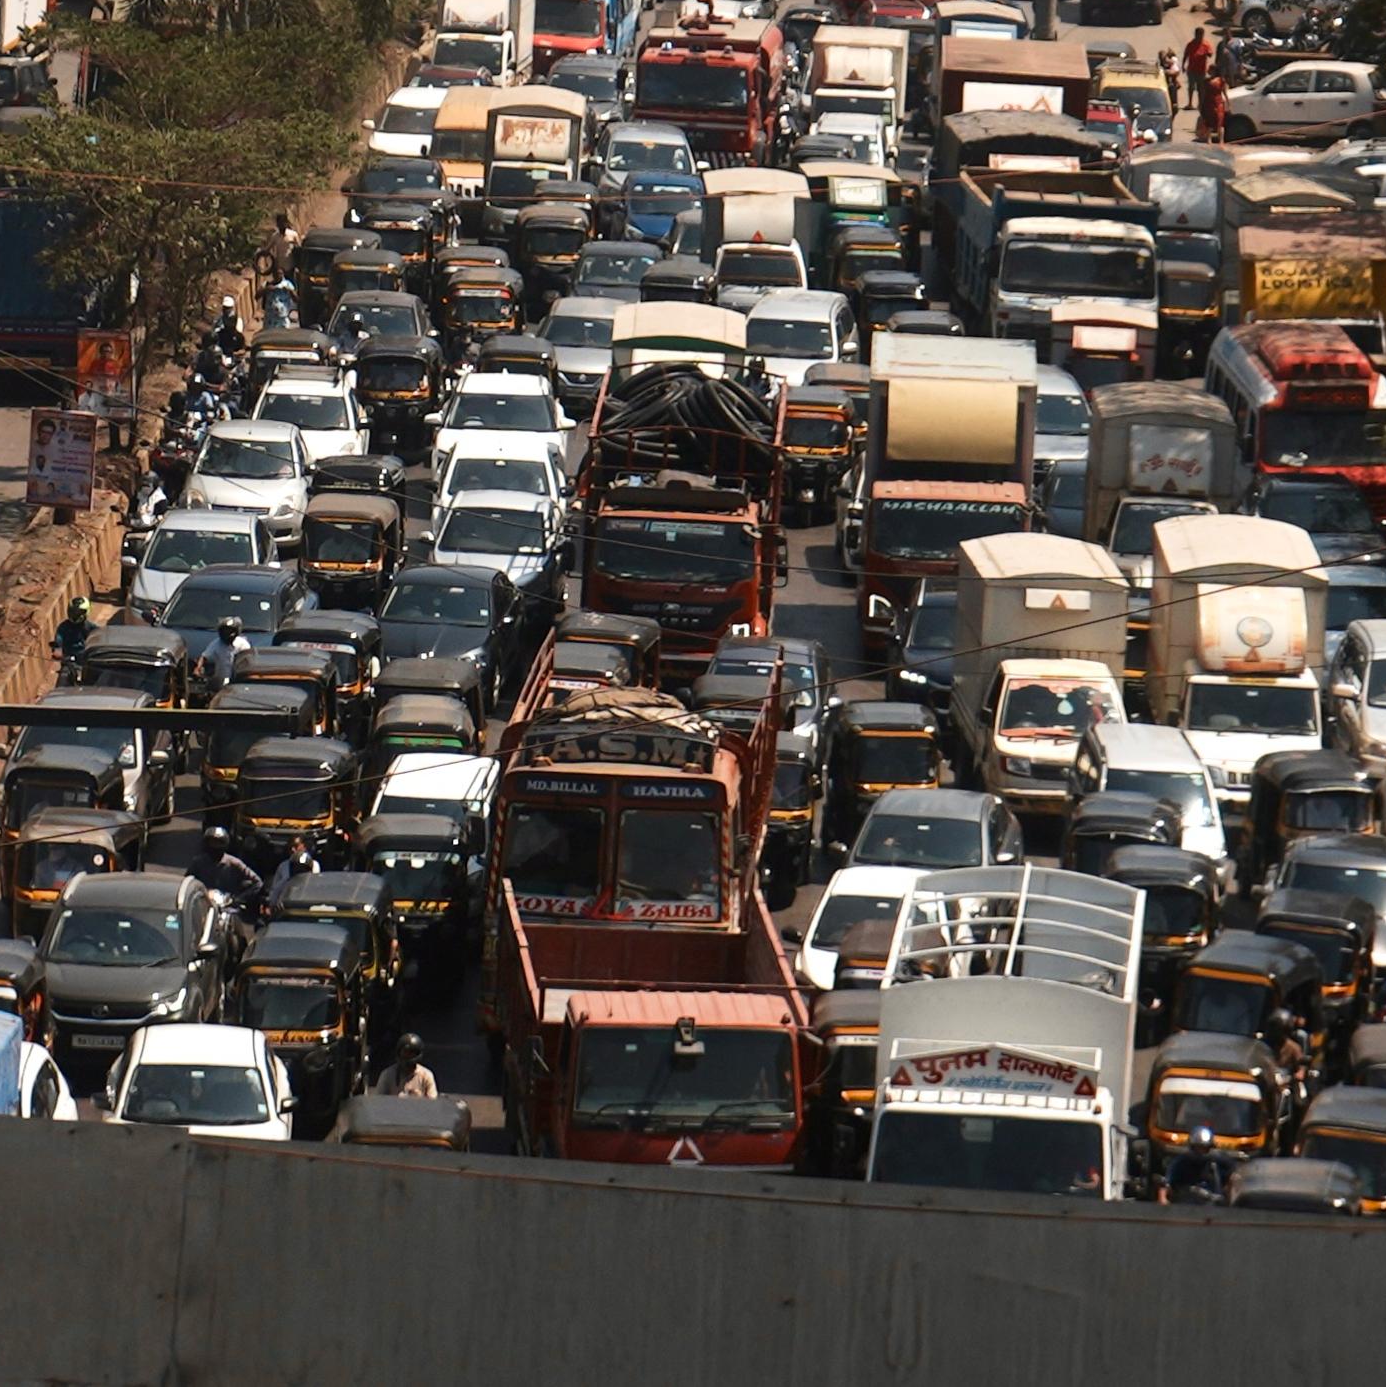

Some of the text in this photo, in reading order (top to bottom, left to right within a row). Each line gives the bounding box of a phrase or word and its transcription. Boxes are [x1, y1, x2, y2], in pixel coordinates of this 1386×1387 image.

[882, 501, 1016, 515] MASHAALLAH
[550, 733, 689, 762] A.S.M
[527, 780, 598, 794] MD.BILLAL
[633, 785, 705, 798] HAJIRA
[640, 903, 713, 918] ZAIBA
[911, 1050, 990, 1084] पुनम
